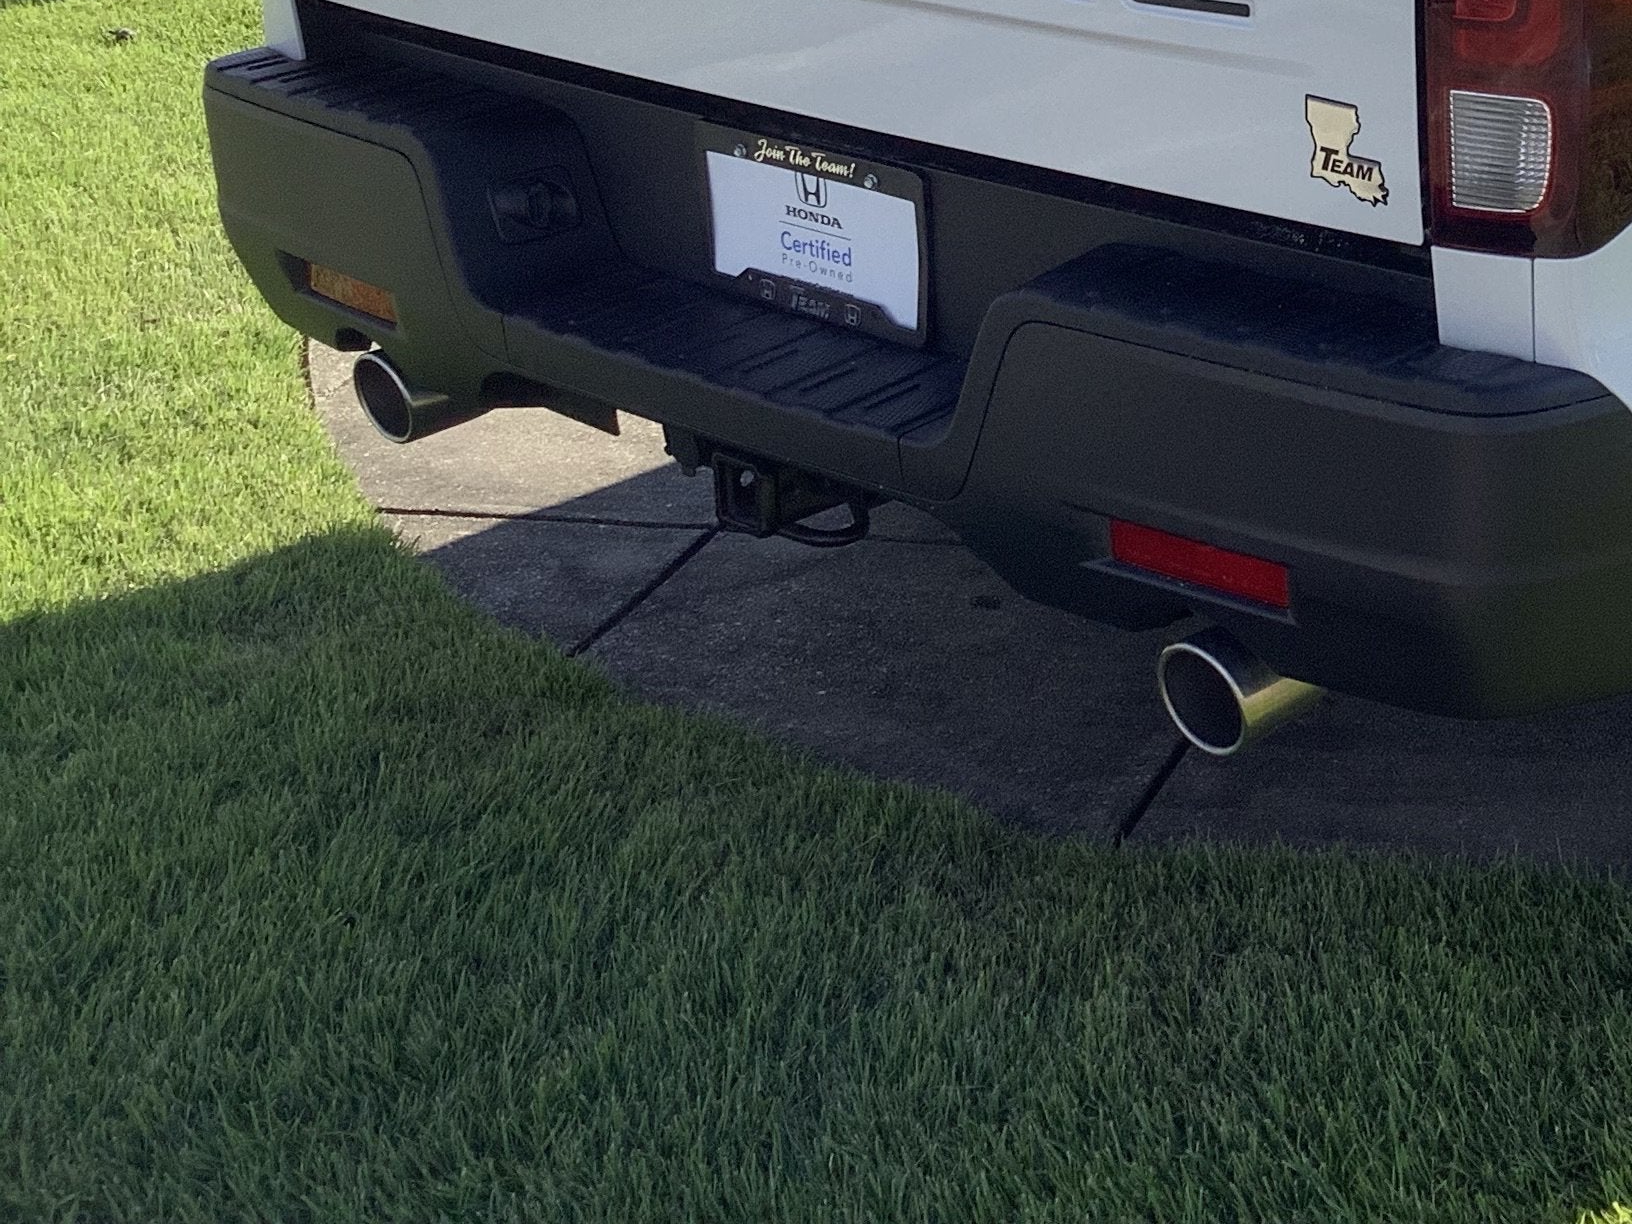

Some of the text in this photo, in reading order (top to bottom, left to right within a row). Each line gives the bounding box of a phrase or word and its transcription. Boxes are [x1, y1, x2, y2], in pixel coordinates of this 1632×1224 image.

[754, 139, 856, 178] Join The Team!
[1320, 146, 1374, 181] TEAM
[785, 204, 844, 230] HONDA
[780, 230, 852, 267] Certified
[782, 253, 853, 283] Pre-Owned
